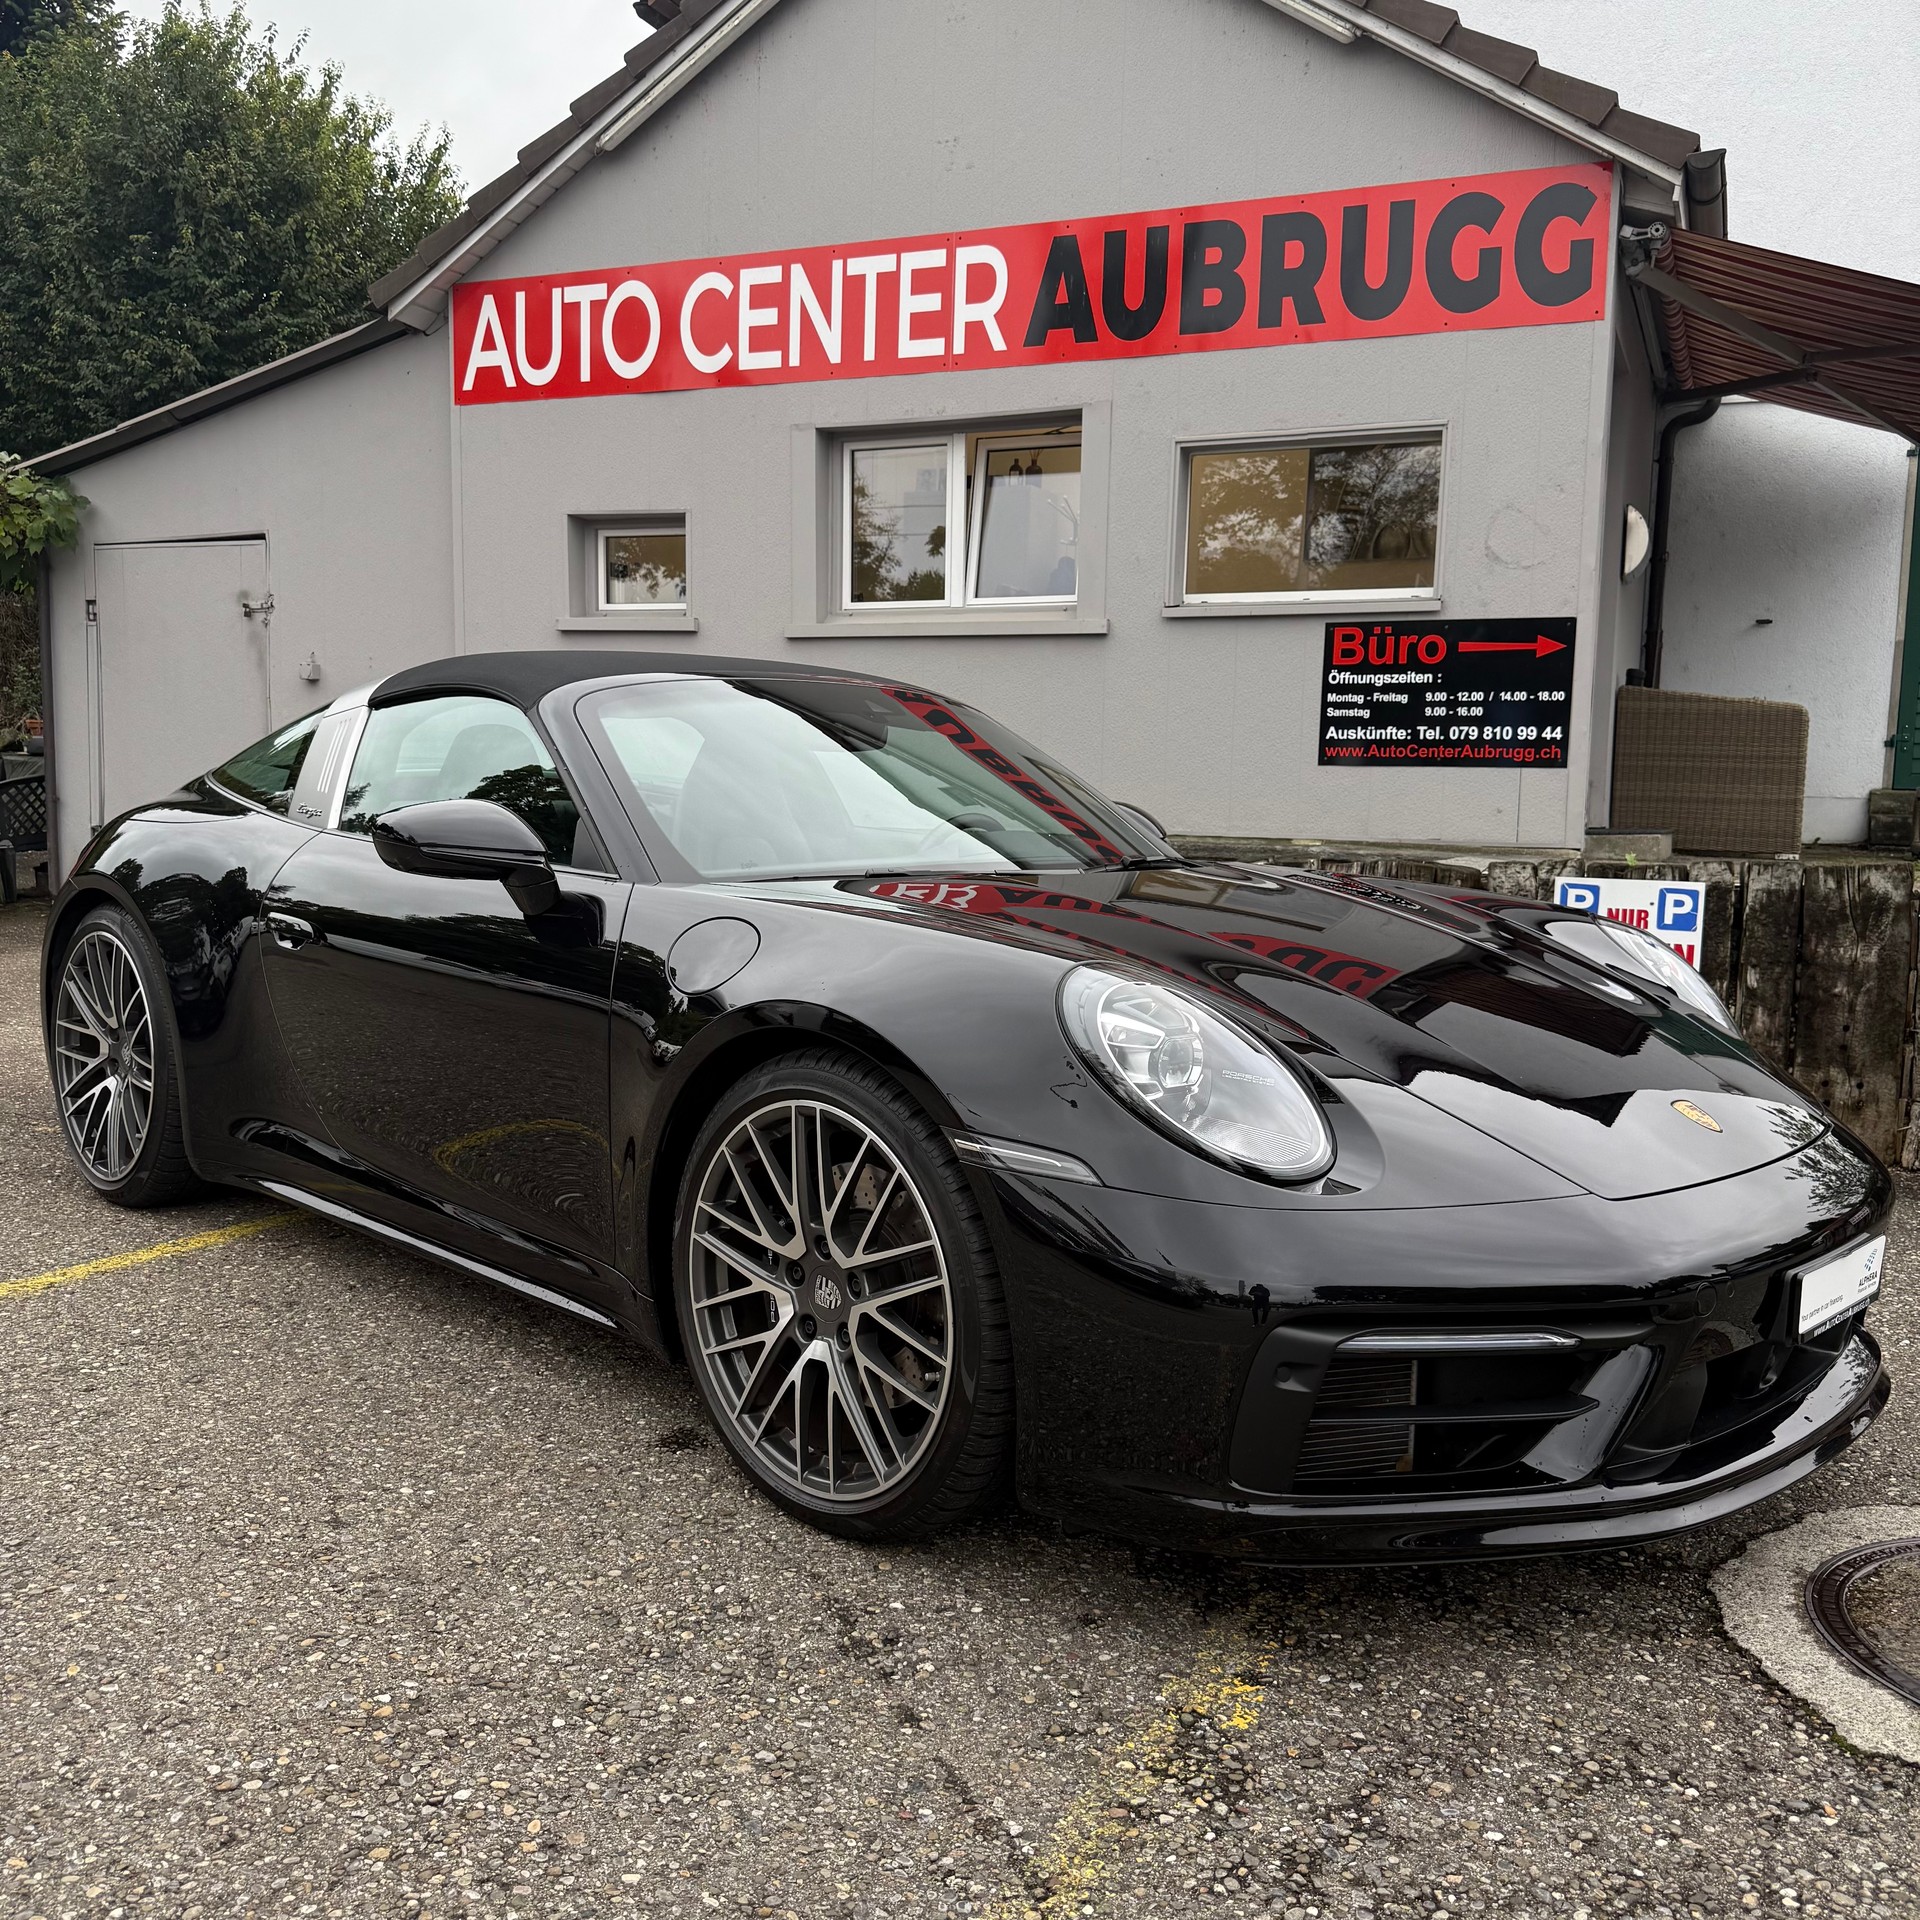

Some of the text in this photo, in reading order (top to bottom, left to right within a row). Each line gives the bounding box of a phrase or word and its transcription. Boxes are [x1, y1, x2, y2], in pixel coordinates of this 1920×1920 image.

[463, 182, 1598, 391] AUTO CENTER AUBRUGG
[1332, 626, 1447, 666] Büro
[1328, 669, 1433, 686] Öffnungszeiten
[1327, 692, 1364, 704] Montag
[1373, 692, 1408, 704] Freitag
[1425, 691, 1447, 702] 9.00
[1456, 691, 1484, 702] 12.00
[1499, 691, 1527, 701] 14.00
[1537, 691, 1565, 701] 18.00
[1326, 707, 1371, 719] Samstag
[1424, 707, 1446, 717] 9.00
[1455, 706, 1483, 717] 16.00
[1325, 726, 1563, 740] Auskünfte: Tel. 079 810 99 44
[1325, 744, 1561, 761] www.AutoCenterAubrugg.ch
